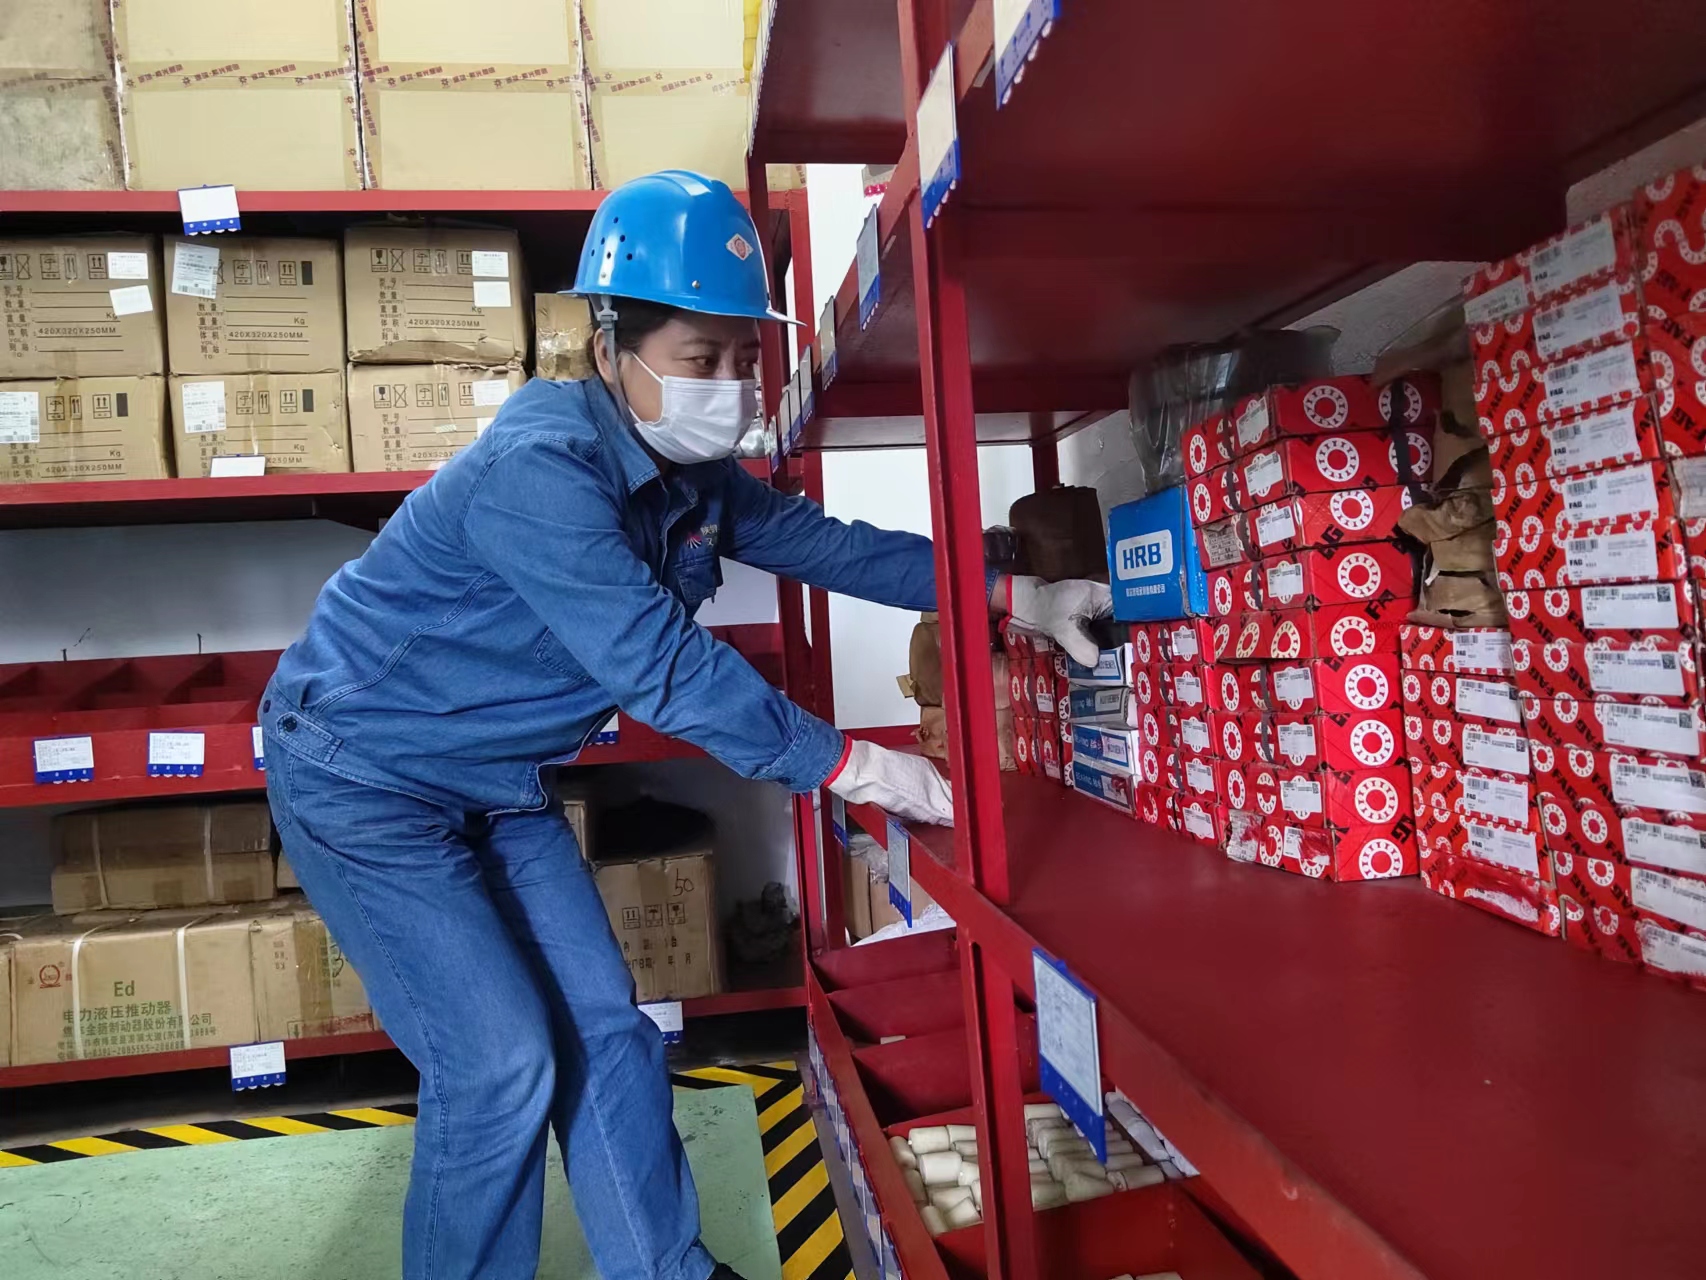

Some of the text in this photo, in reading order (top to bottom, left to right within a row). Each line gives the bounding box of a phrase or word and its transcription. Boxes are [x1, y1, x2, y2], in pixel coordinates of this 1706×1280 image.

[294, 317, 305, 325] Kg
[409, 319, 480, 327] 420X320X250MM
[1550, 388, 1563, 396] FAG
[1554, 447, 1566, 455] FAG
[1505, 496, 1522, 523] FAG
[1537, 490, 1556, 518] FAG
[1569, 501, 1583, 509] FAG
[1123, 542, 1162, 570] HRB
[1507, 549, 1524, 575] FAG
[1538, 544, 1557, 572] FAG
[1420, 771, 1434, 792] FAG
[1443, 777, 1458, 797] FAG
[1467, 792, 1477, 800] FAG
[1422, 816, 1436, 835] FAG
[1447, 822, 1463, 842] FAG
[114, 980, 135, 997] Ed
